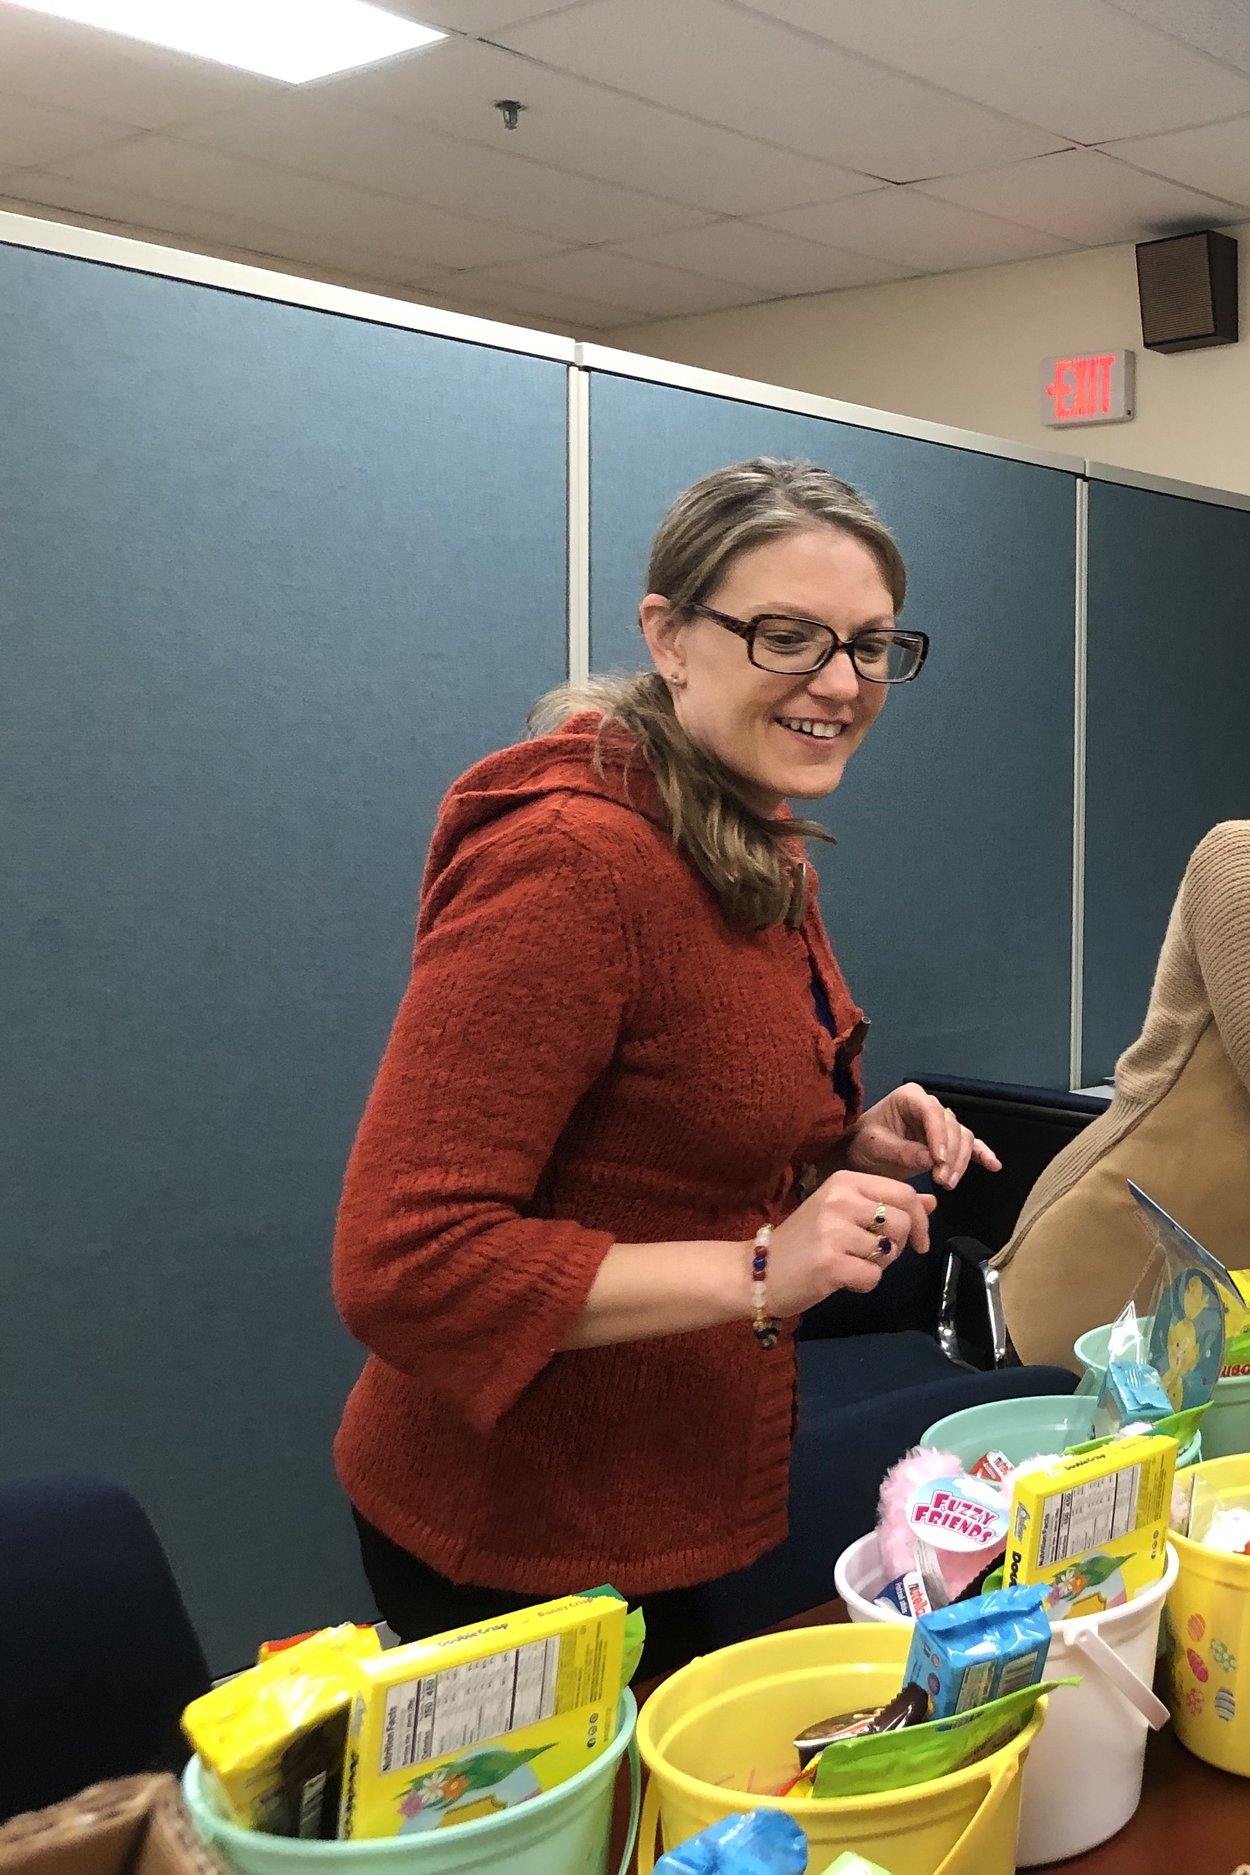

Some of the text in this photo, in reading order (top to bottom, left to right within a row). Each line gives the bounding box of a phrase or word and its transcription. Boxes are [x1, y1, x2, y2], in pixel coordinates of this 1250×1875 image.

[1055, 353, 1114, 419] EXIT
[914, 1505, 993, 1543] FRIENDS
[933, 1493, 997, 1526] FUZZY
[1008, 1550, 1022, 1587] Dou
[908, 1583, 928, 1617] nutella
[425, 1679, 434, 1695] 450
[424, 1702, 432, 1718] 150
[382, 1705, 398, 1771] Nutrition Facts
